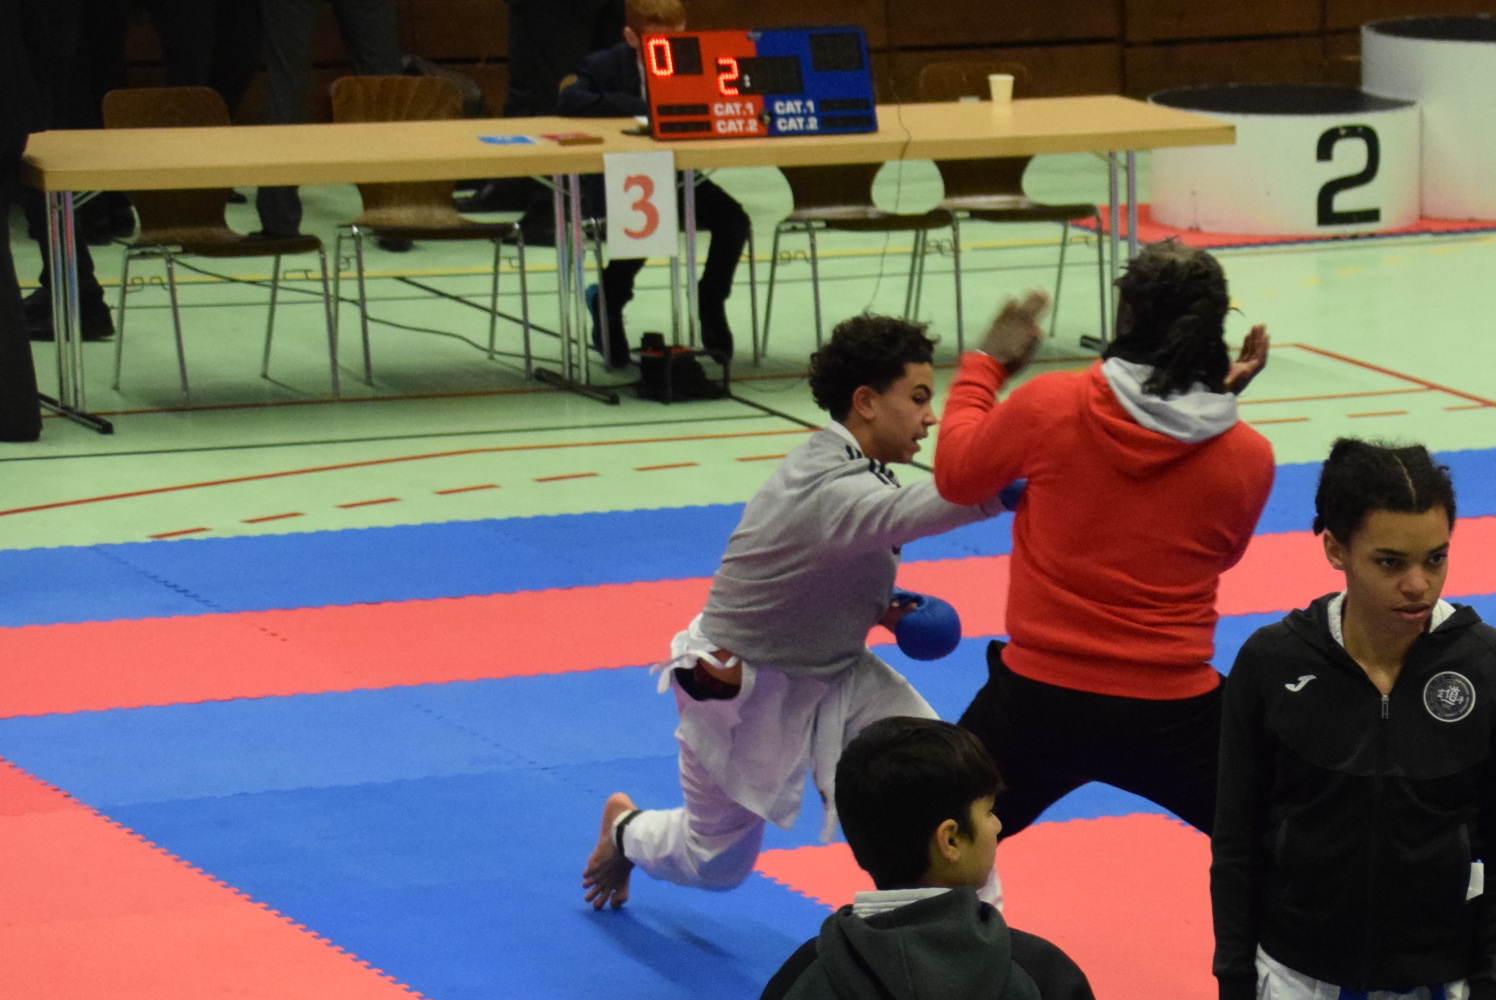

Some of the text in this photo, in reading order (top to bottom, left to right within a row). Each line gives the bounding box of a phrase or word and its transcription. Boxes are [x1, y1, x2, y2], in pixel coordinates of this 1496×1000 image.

[648, 37, 673, 76] 0
[717, 56, 739, 96] 2
[713, 102, 754, 116] CAT.1
[774, 99, 815, 115] CAT.1
[716, 118, 758, 133] CAT.2
[776, 116, 819, 132] CAT.2
[1316, 124, 1381, 226] 2
[623, 174, 659, 240] 3
